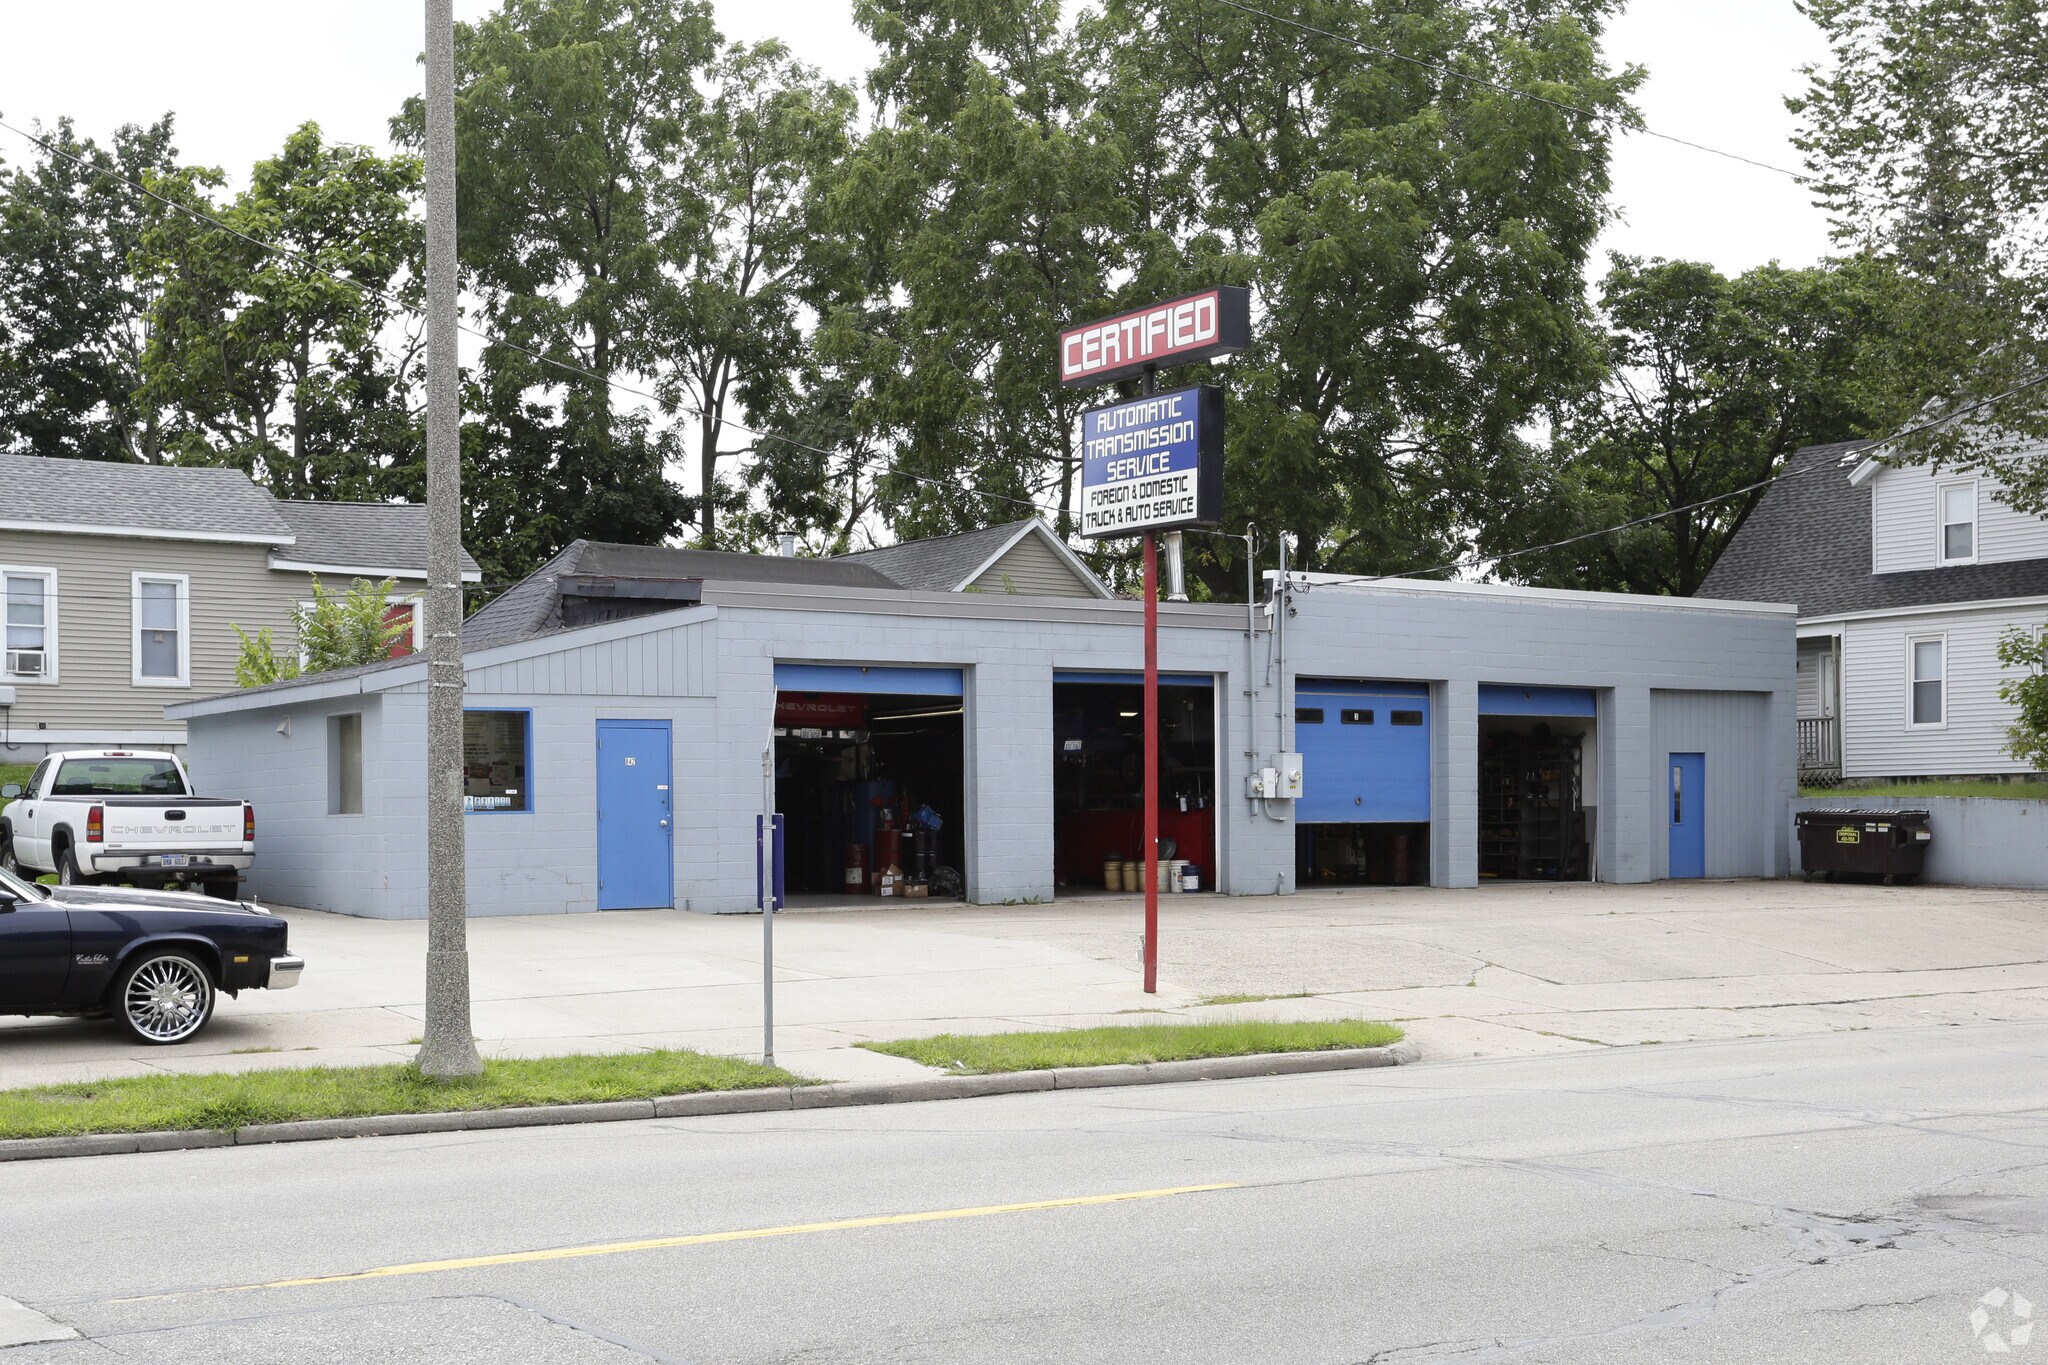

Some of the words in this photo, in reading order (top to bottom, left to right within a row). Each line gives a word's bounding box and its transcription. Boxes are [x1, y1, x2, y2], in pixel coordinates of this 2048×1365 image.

[1063, 296, 1216, 376] CERTIFIED
[1097, 396, 1182, 433] AUTOMATIC
[1086, 420, 1194, 460] TRANSMISSION
[1106, 451, 1170, 482] SERVICE
[1091, 485, 1129, 507] FOREIGN
[1132, 484, 1138, 500] &
[1140, 475, 1188, 499] DOMESTIC
[1085, 508, 1116, 528] TRUCK
[1118, 508, 1124, 523] &
[1125, 503, 1151, 523] AUTO
[1153, 496, 1194, 519] SERVICE
[776, 702, 856, 712] HEVROLET
[111, 825, 236, 834] CHEVROLET
